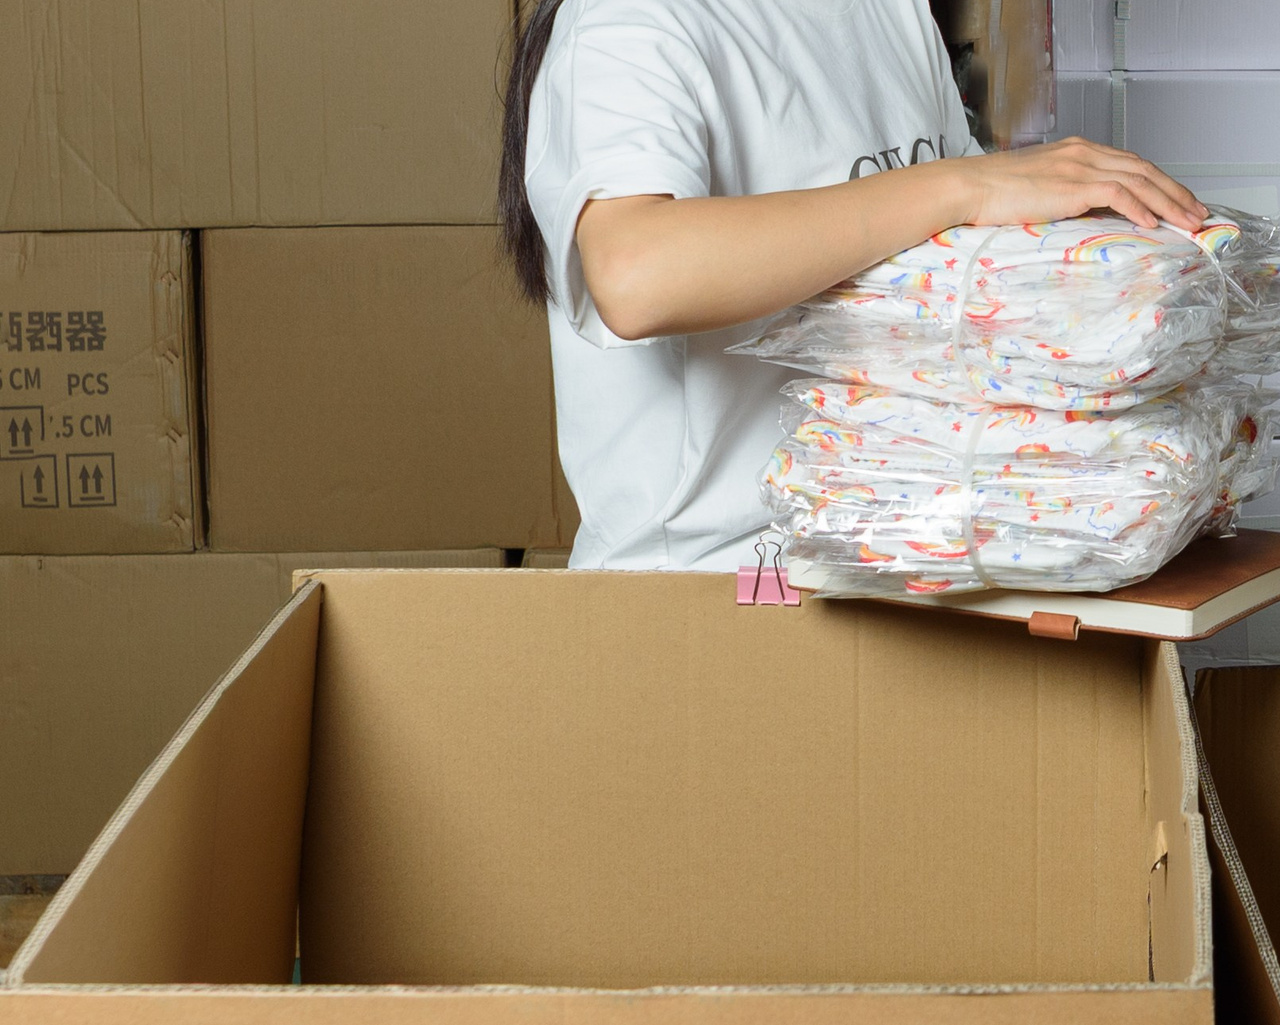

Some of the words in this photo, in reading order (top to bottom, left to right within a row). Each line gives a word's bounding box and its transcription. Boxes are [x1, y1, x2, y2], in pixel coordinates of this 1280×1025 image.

[9, 368, 41, 390] CM
[67, 373, 109, 396] PCS
[80, 414, 112, 437] CM
